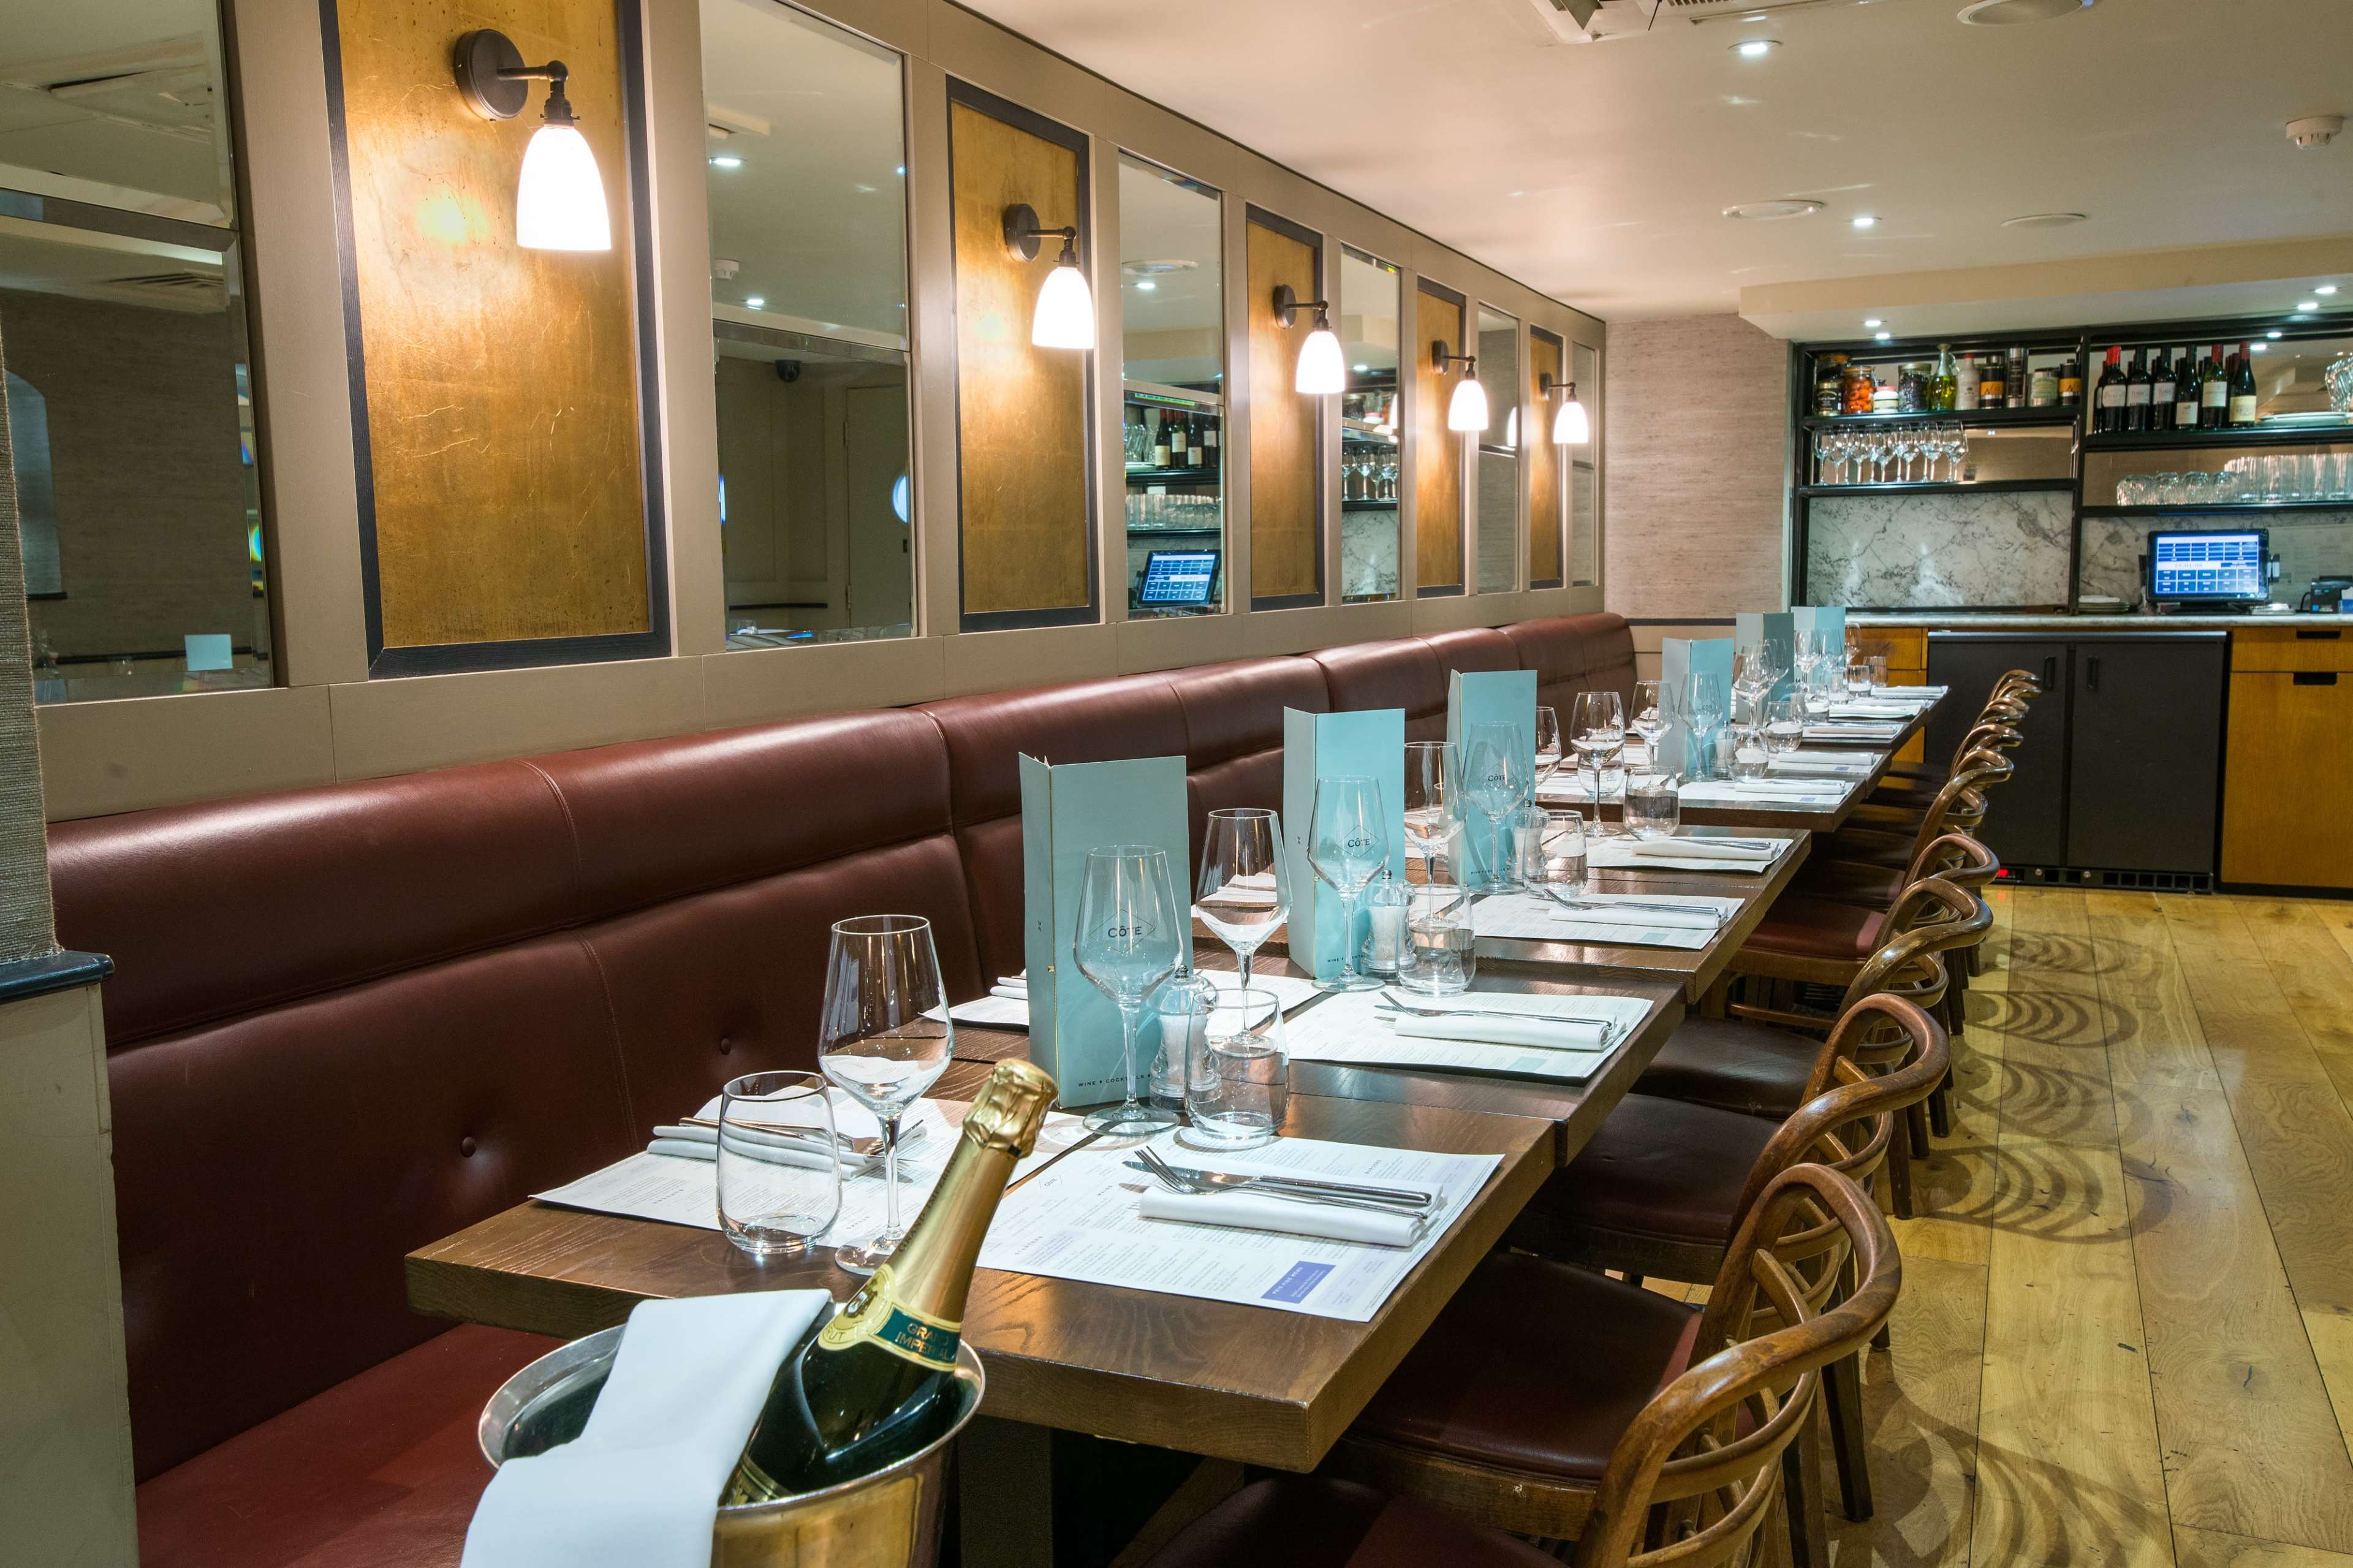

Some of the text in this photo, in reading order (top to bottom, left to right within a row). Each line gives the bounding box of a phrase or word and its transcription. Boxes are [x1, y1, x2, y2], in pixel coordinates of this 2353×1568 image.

[1347, 838, 1370, 847] CÔTE
[1107, 925, 1142, 938] CÔTE
[1106, 1074, 1145, 1083] COCKTLS
[895, 1331, 949, 1360] IMPERAL
